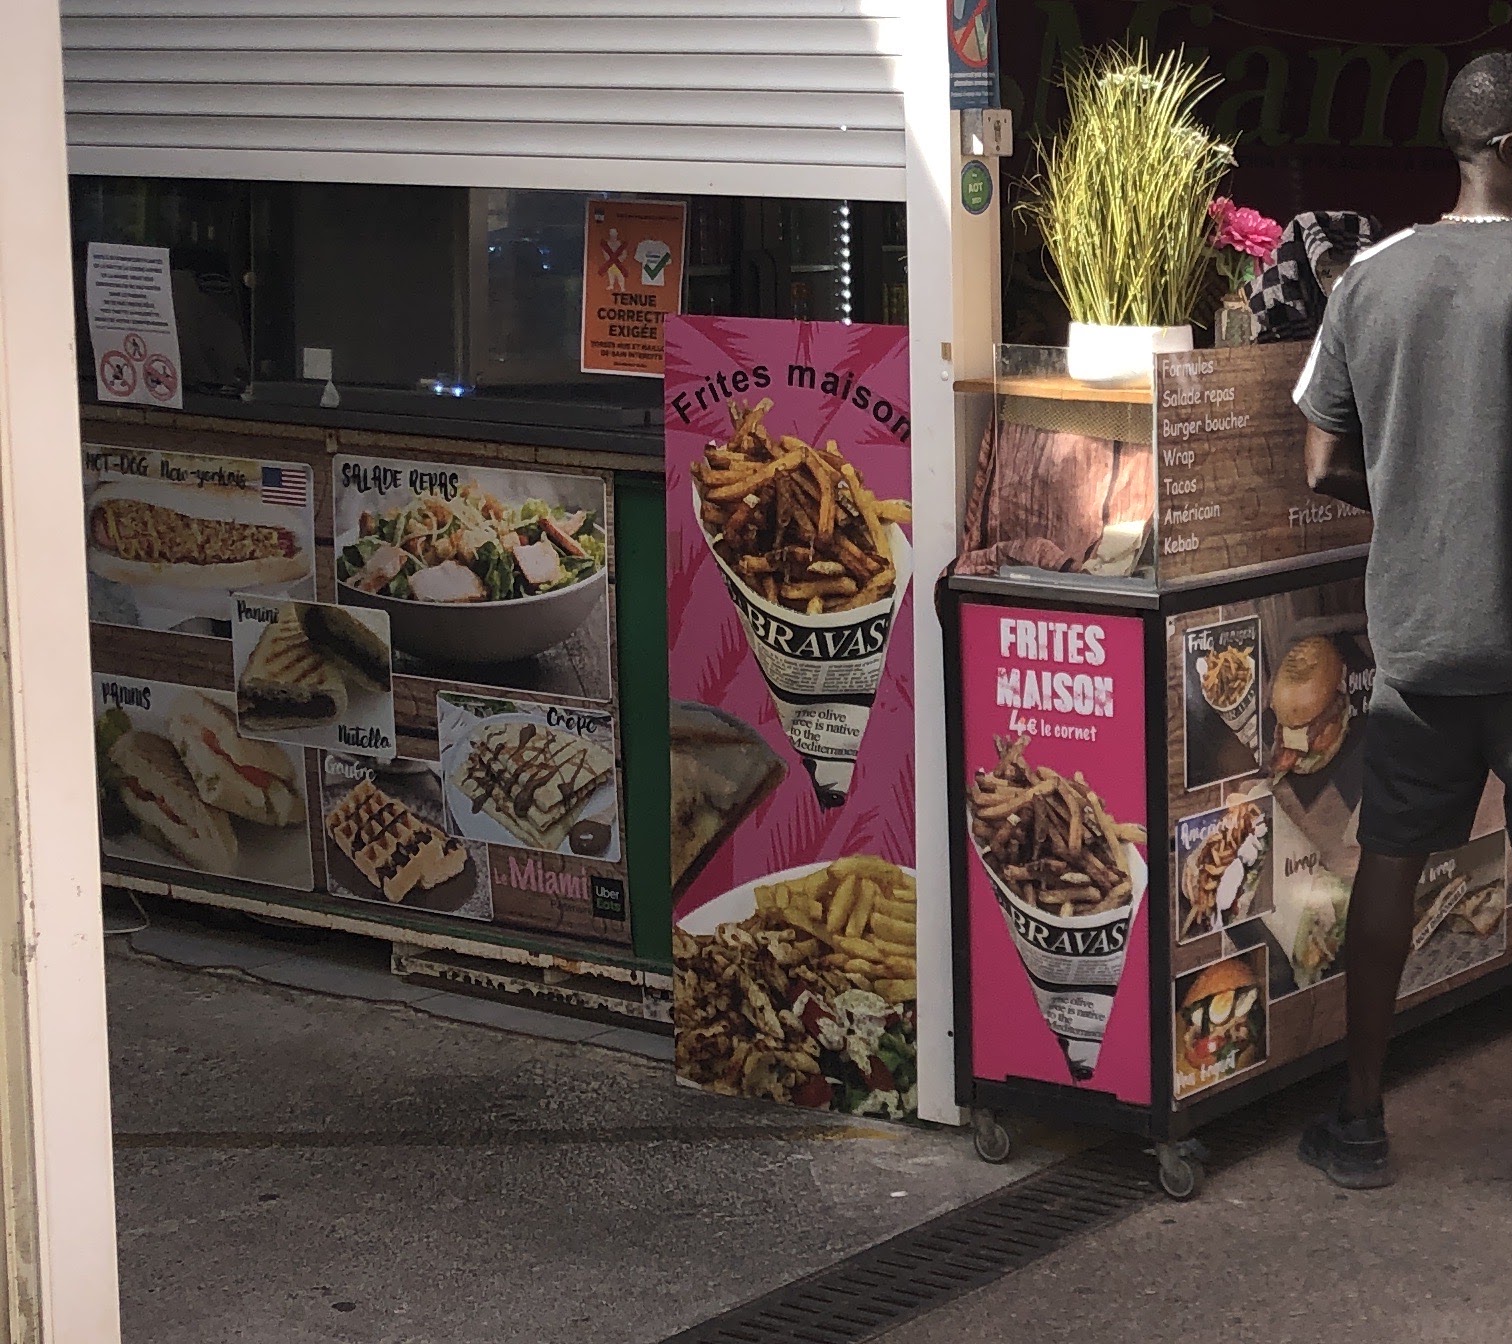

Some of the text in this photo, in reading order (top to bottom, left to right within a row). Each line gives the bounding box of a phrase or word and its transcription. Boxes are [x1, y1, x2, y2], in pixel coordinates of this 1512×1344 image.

[612, 293, 657, 308] TENUE
[608, 323, 657, 339] EXIGÉE
[1162, 359, 1215, 380] Formules
[671, 364, 912, 444] Frites maison
[1162, 386, 1236, 408] Salade repas
[1163, 411, 1251, 441] Burger boucher
[1163, 449, 1196, 470] Wrap
[342, 462, 460, 502] SALADE REPAS
[1164, 477, 1198, 497] Tacos
[1164, 501, 1222, 526] Américain
[1288, 501, 1334, 529] Frites
[1164, 532, 1200, 556] Kebab
[236, 599, 280, 625] Panini
[748, 605, 886, 658] BRAVAS
[1000, 618, 1106, 666] FRITES
[996, 667, 1114, 718] MAISON
[818, 709, 847, 723] olive
[338, 725, 392, 751] Nutella
[803, 729, 821, 742] the
[815, 719, 824, 730] is
[826, 722, 860, 738] native
[1041, 719, 1052, 736] le
[1054, 724, 1098, 742] cornet
[508, 856, 590, 901] Miami
[595, 885, 620, 901] Uber
[596, 899, 621, 913] Eats
[1011, 906, 1126, 955] BRAVAS
